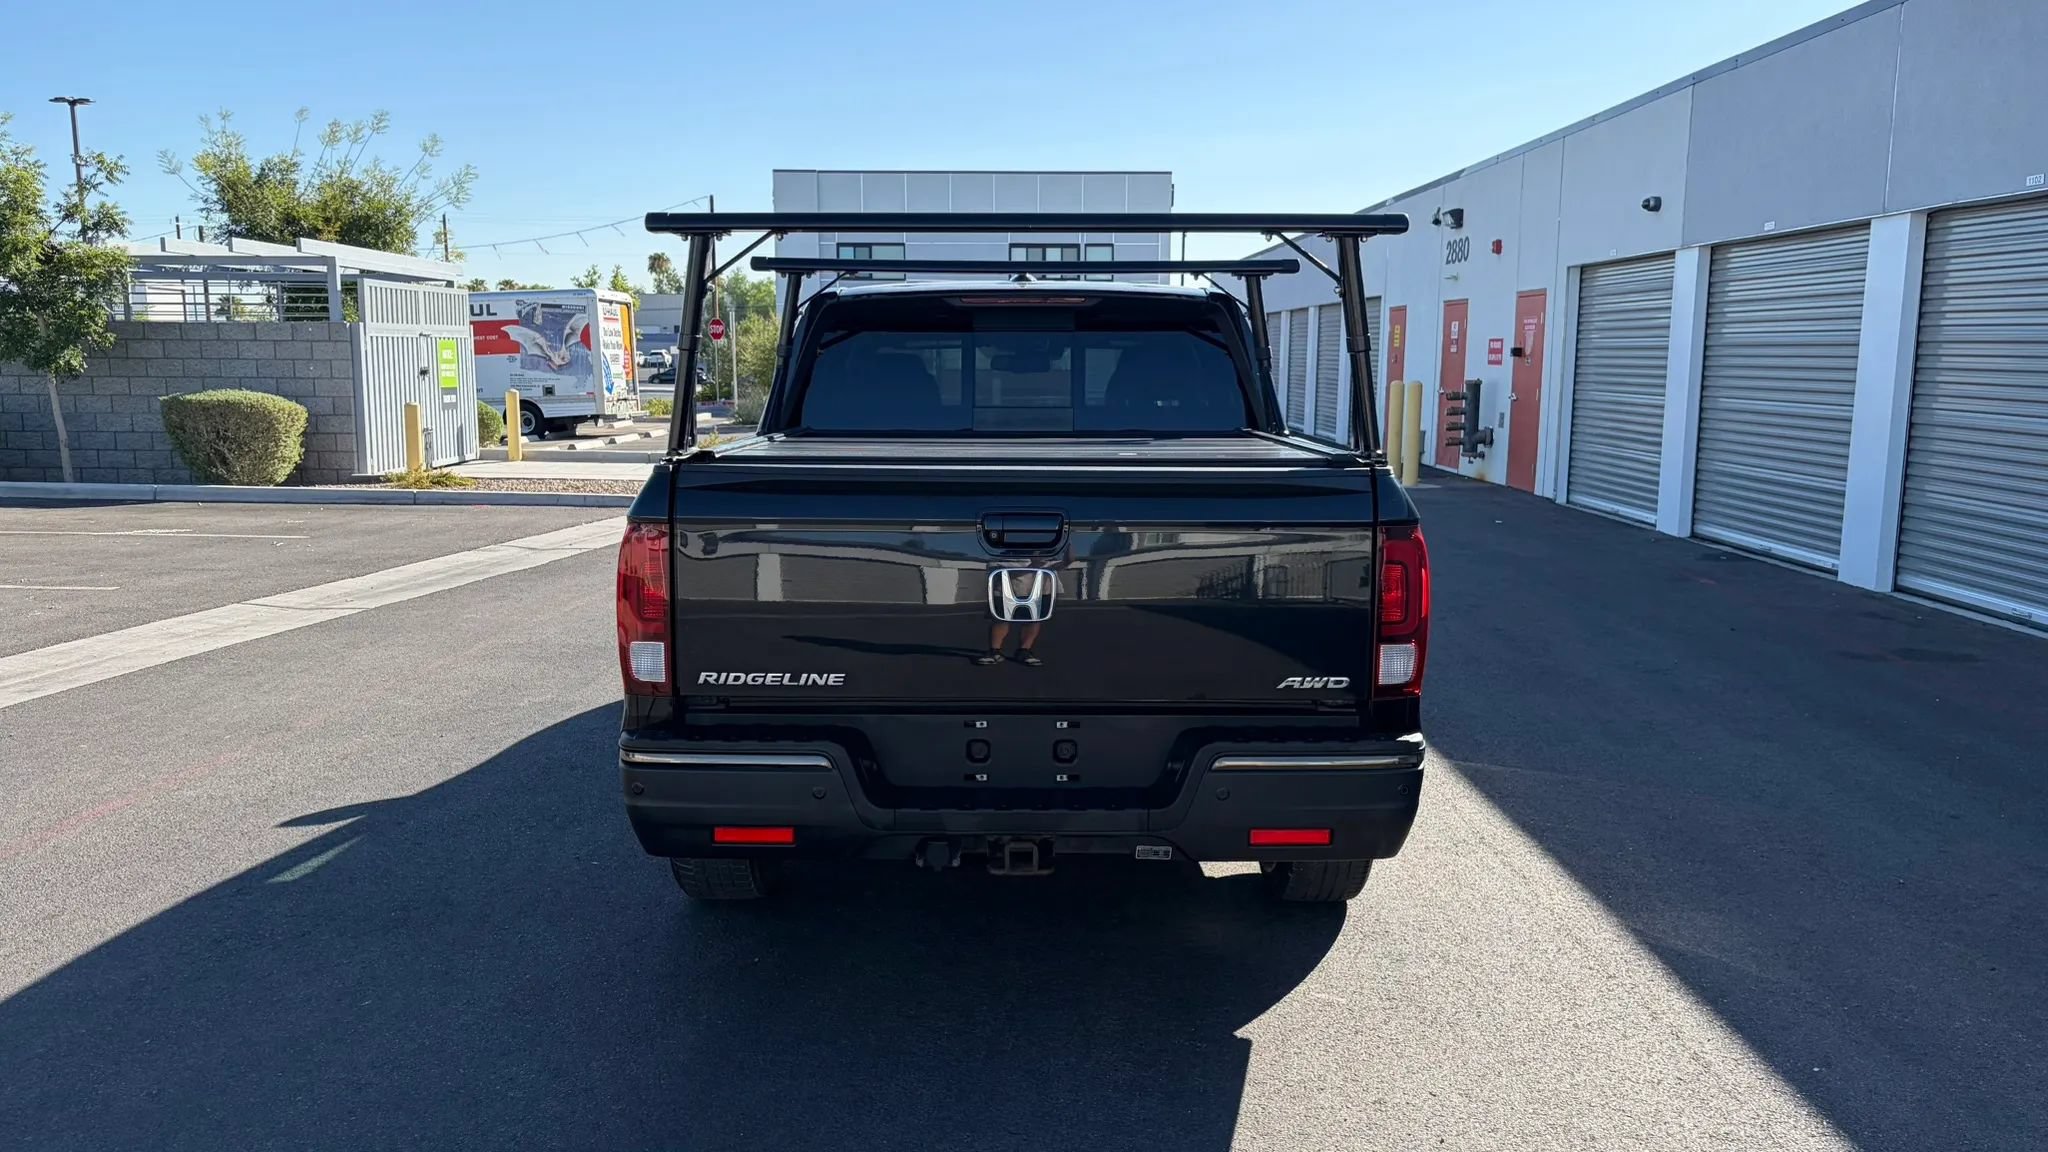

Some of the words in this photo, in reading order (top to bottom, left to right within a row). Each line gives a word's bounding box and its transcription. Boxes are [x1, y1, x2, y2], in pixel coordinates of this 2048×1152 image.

[1446, 236, 1470, 265] 2880
[710, 325, 724, 334] STOP
[697, 671, 846, 686] RIDGELINE
[1276, 677, 1350, 689] AWD
